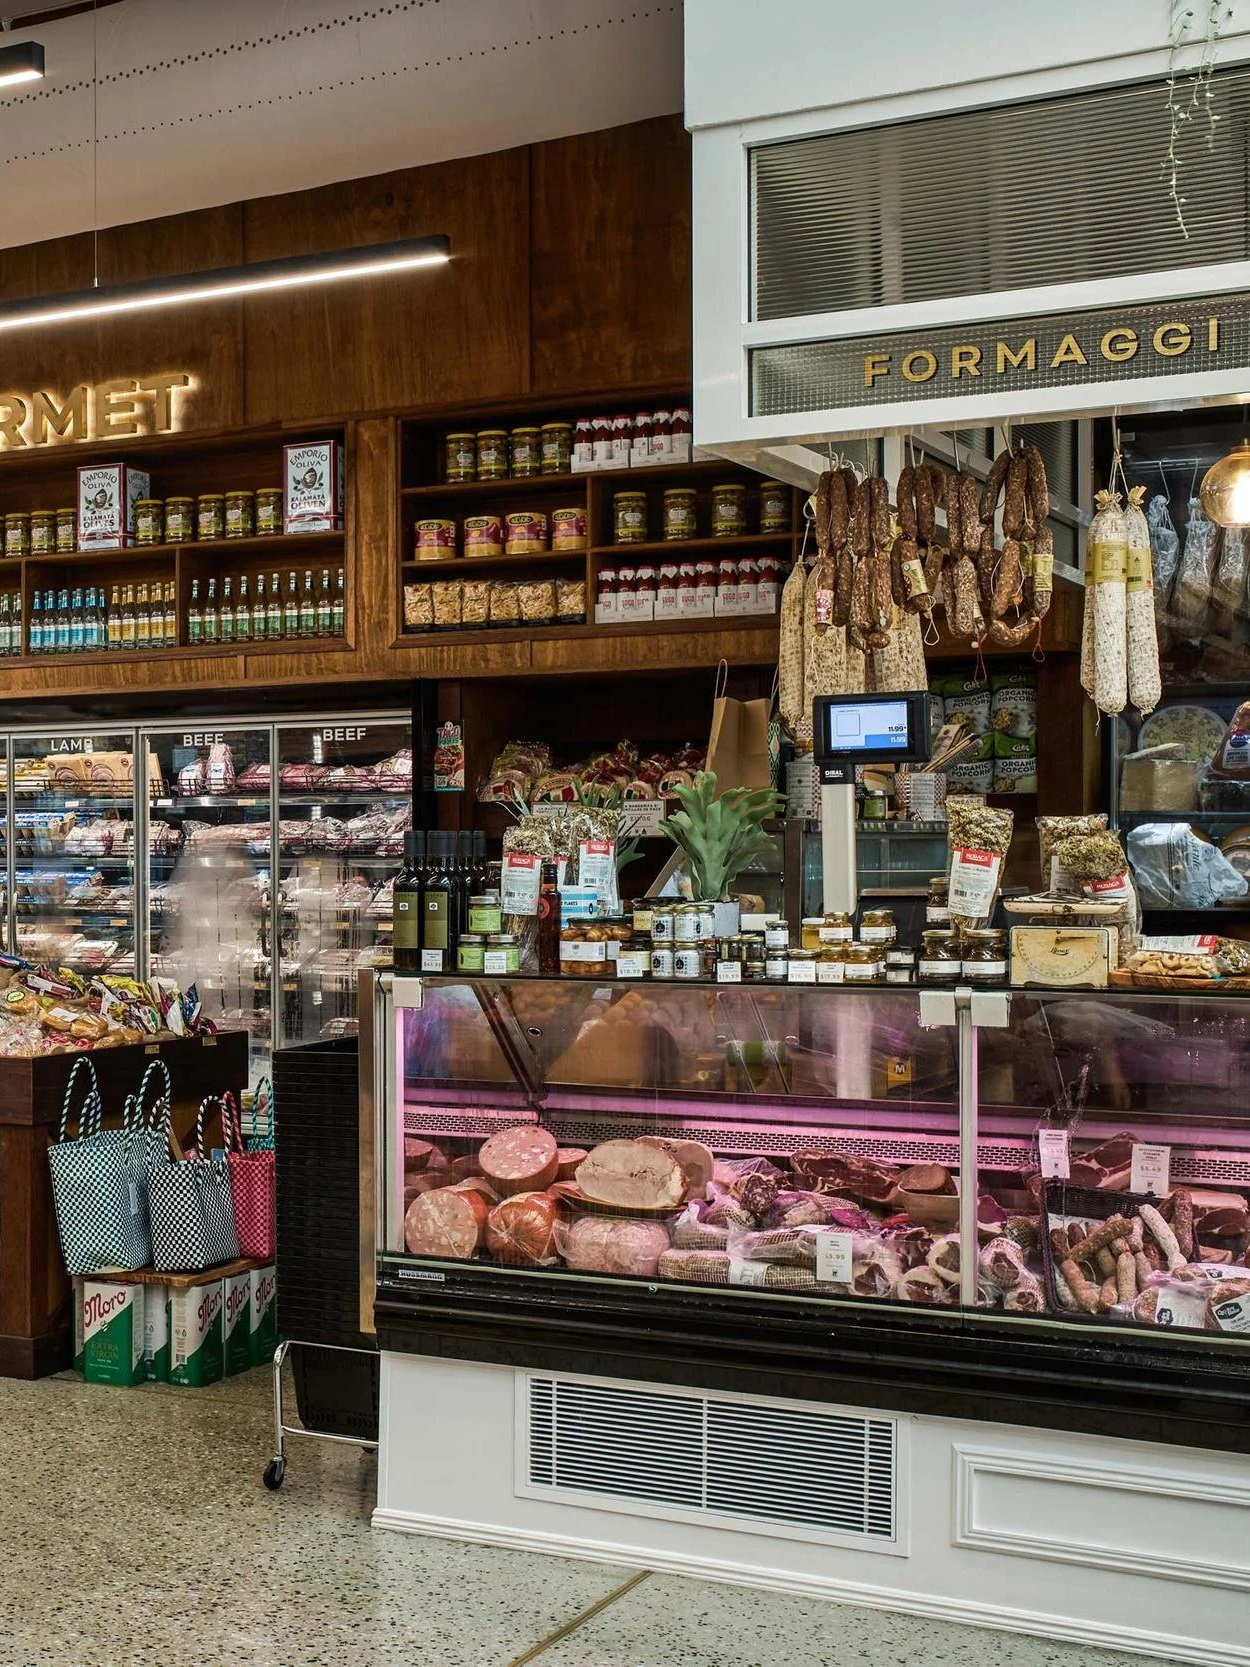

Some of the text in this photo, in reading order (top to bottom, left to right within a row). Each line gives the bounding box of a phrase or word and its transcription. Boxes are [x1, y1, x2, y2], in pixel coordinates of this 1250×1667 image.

[864, 315, 1220, 387] FORMAGGI
[290, 450, 328, 466] EMPORIO
[82, 471, 118, 487] EMPORIO
[88, 481, 111, 489] OLIVA
[999, 690, 1037, 698] ORGANIC
[182, 733, 224, 747] BEEF
[323, 727, 366, 741] BEEF
[50, 738, 93, 752] LAMB
[953, 763, 988, 771] ORGANIC
[256, 1275, 275, 1313] Mor
[85, 1290, 126, 1328] Moro
